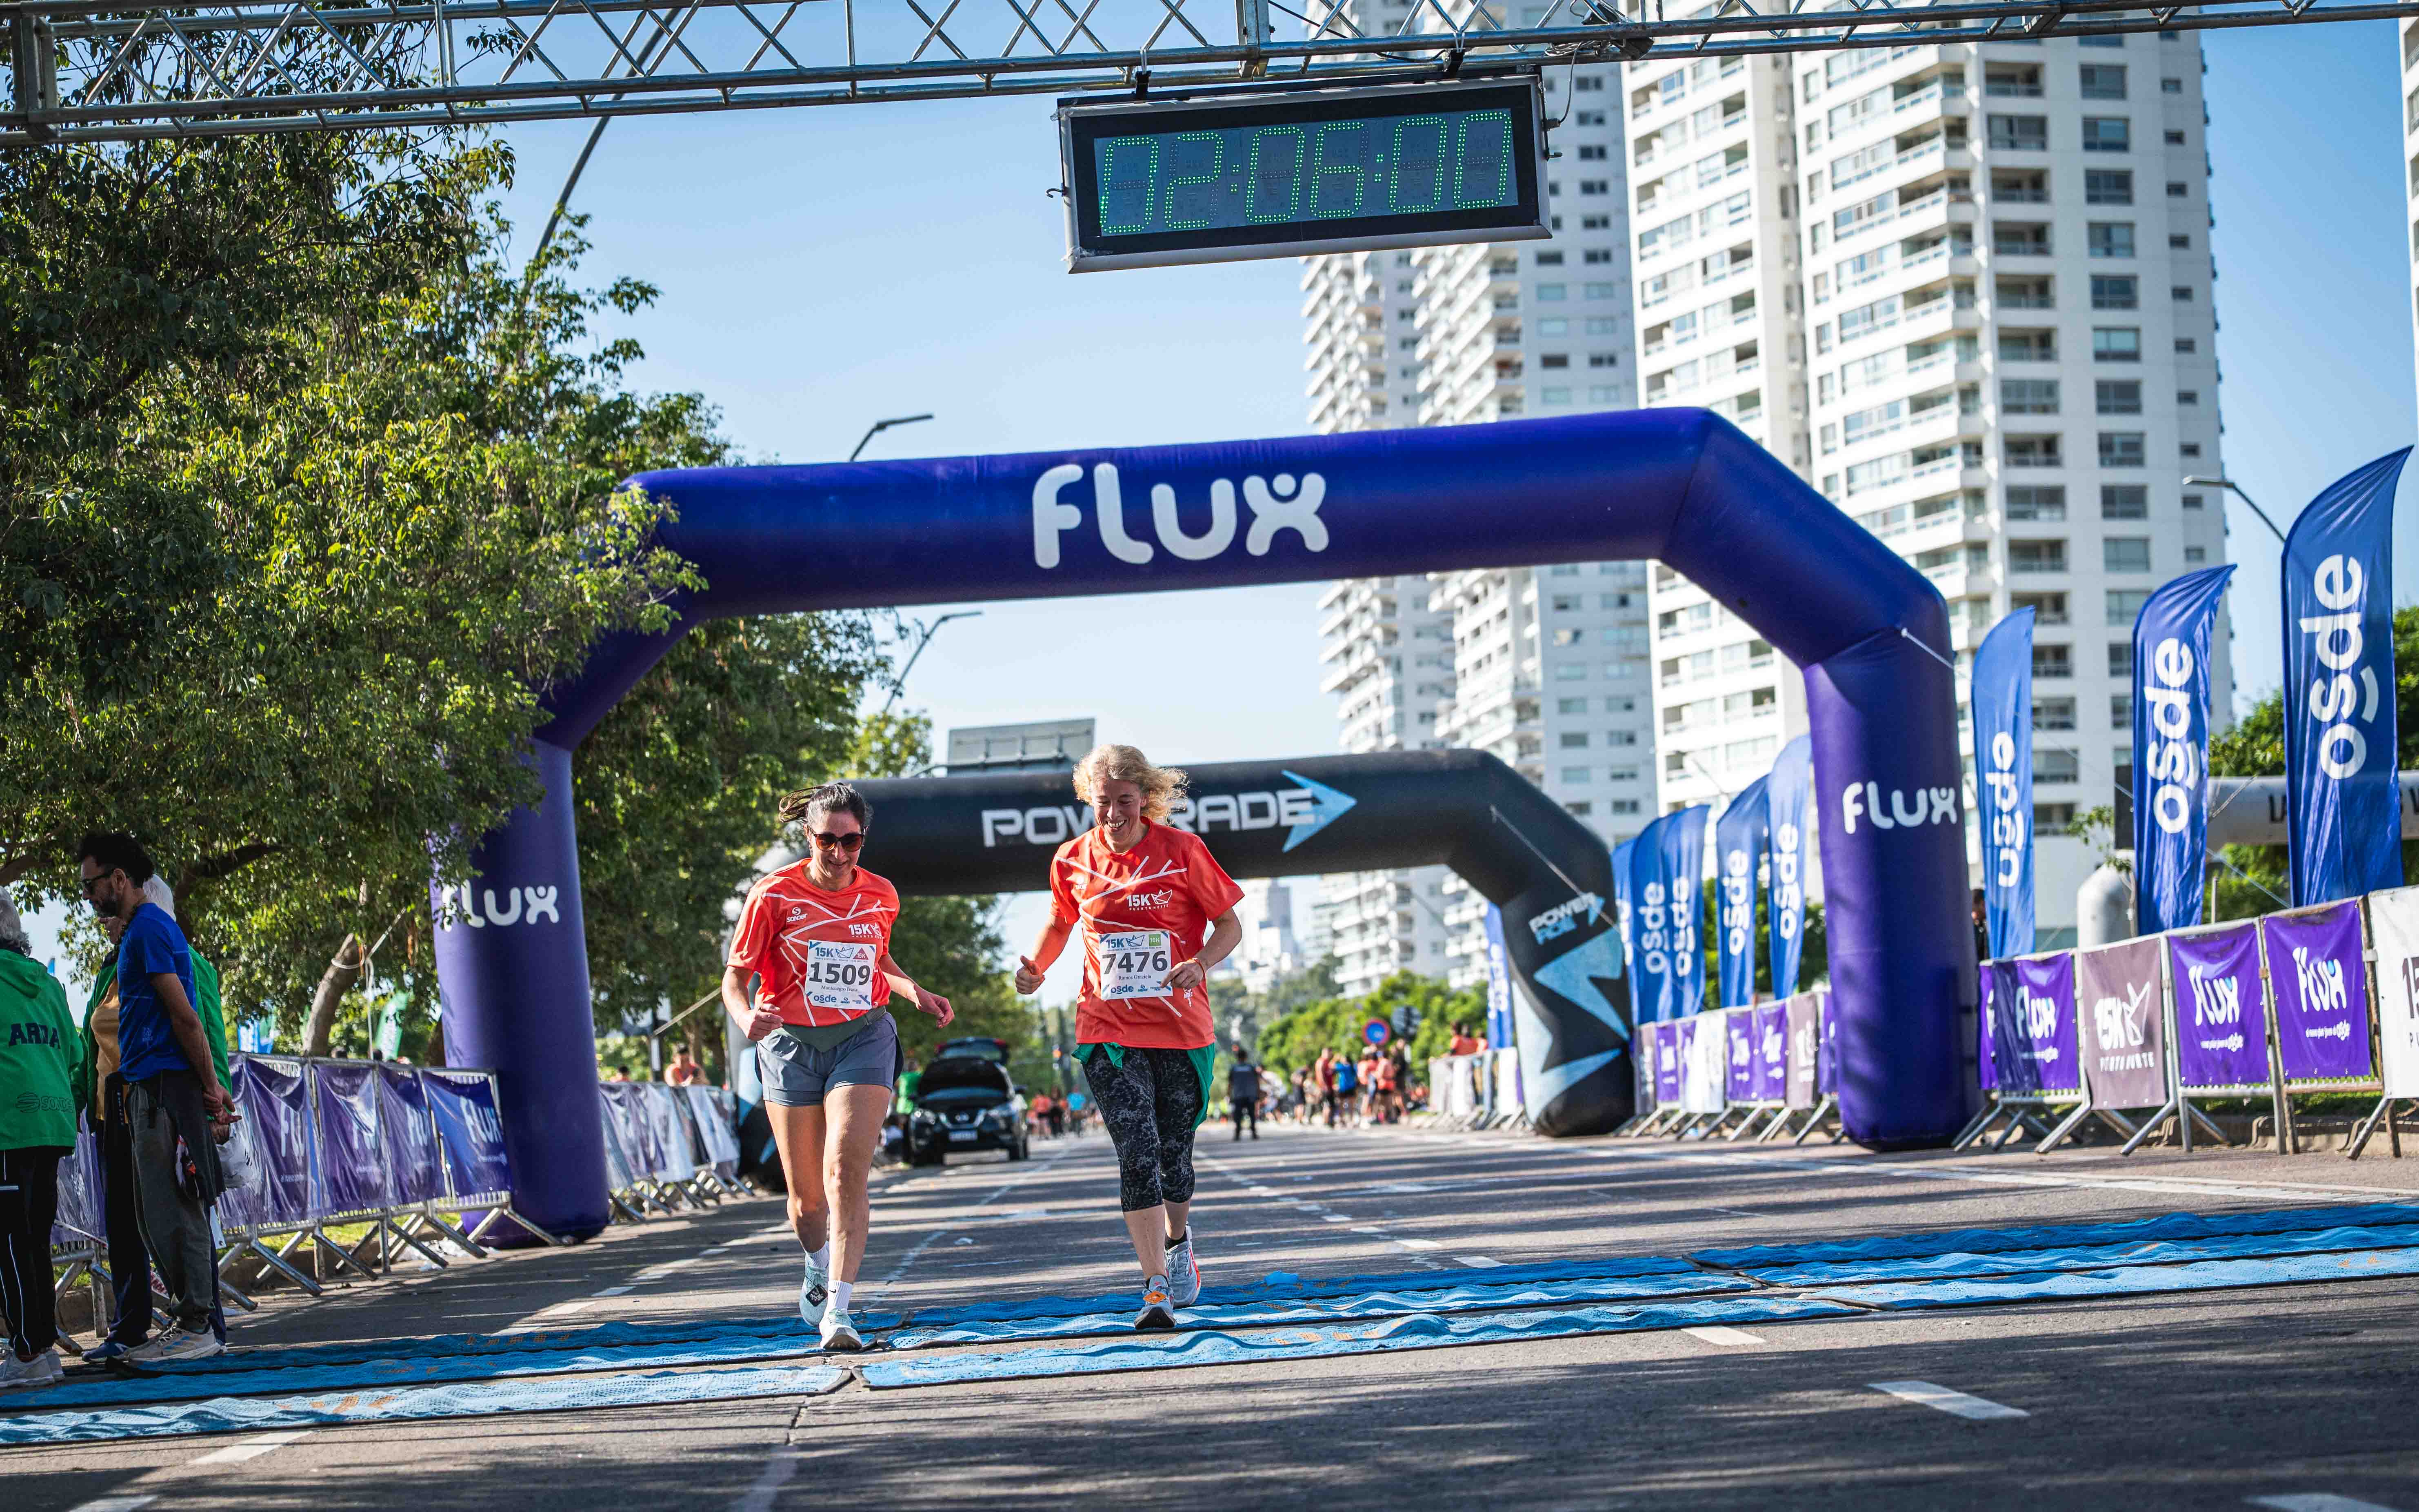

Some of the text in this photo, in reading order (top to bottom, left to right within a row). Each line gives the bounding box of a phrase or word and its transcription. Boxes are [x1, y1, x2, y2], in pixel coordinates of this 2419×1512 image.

[1099, 112, 1513, 234] 02:06:00
[2299, 554, 2379, 780] osde
[2144, 638, 2201, 835] osde
[982, 788, 1313, 847] POWRADE
[1986, 730, 2024, 888] osde
[1773, 823, 1802, 940] osde
[1126, 894, 1151, 907] 15K
[849, 924, 872, 935] 15K
[1637, 881, 1670, 974] osde
[816, 947, 834, 957] 15K
[1106, 937, 1125, 948] 15K
[809, 962, 871, 986] 1509
[1102, 951, 1168, 975] 7476
[813, 995, 837, 1003] osde
[1111, 985, 1134, 994] osde
